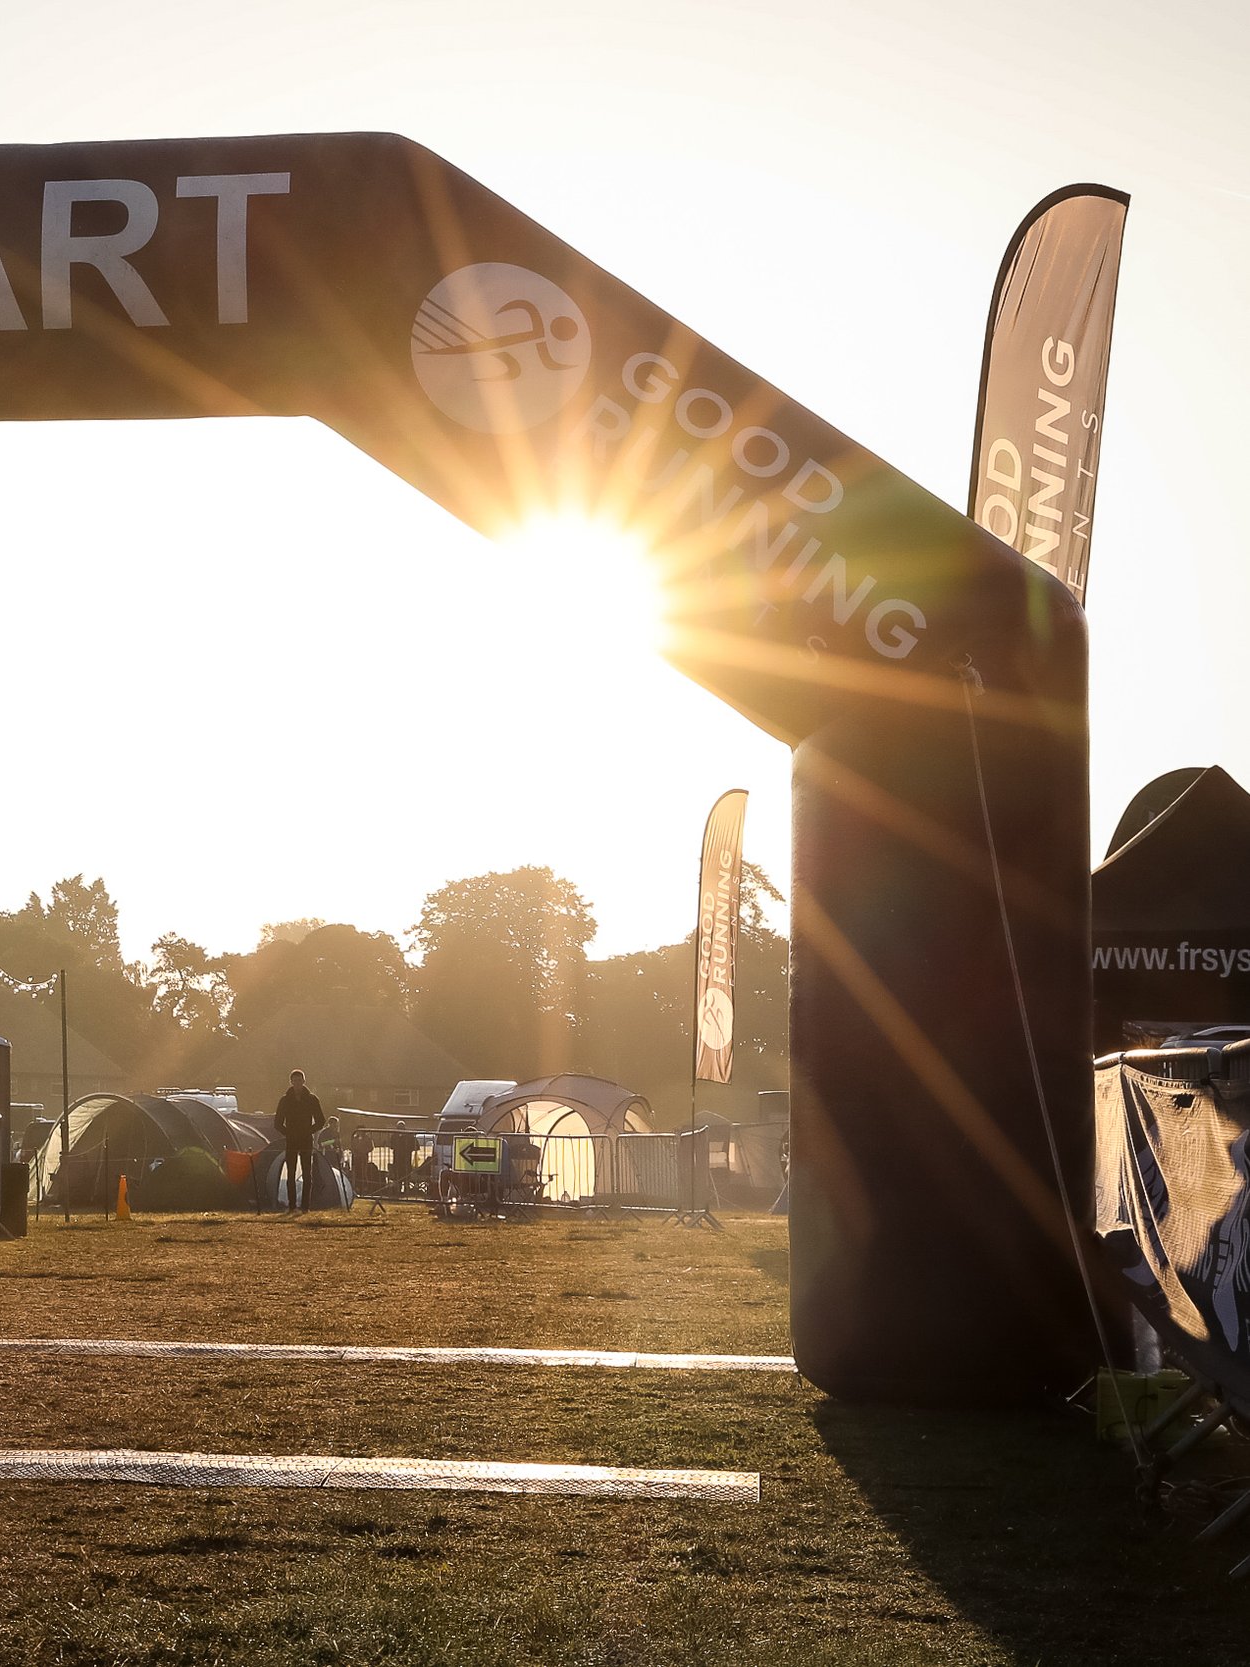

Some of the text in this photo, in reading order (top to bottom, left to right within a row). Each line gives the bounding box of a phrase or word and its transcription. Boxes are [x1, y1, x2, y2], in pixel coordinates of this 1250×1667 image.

[622, 352, 844, 514] GOOD
[981, 437, 1023, 548] OD
[580, 393, 927, 660] RUNNING
[700, 892, 714, 979] GOOD
[714, 849, 732, 984] RUNNING
